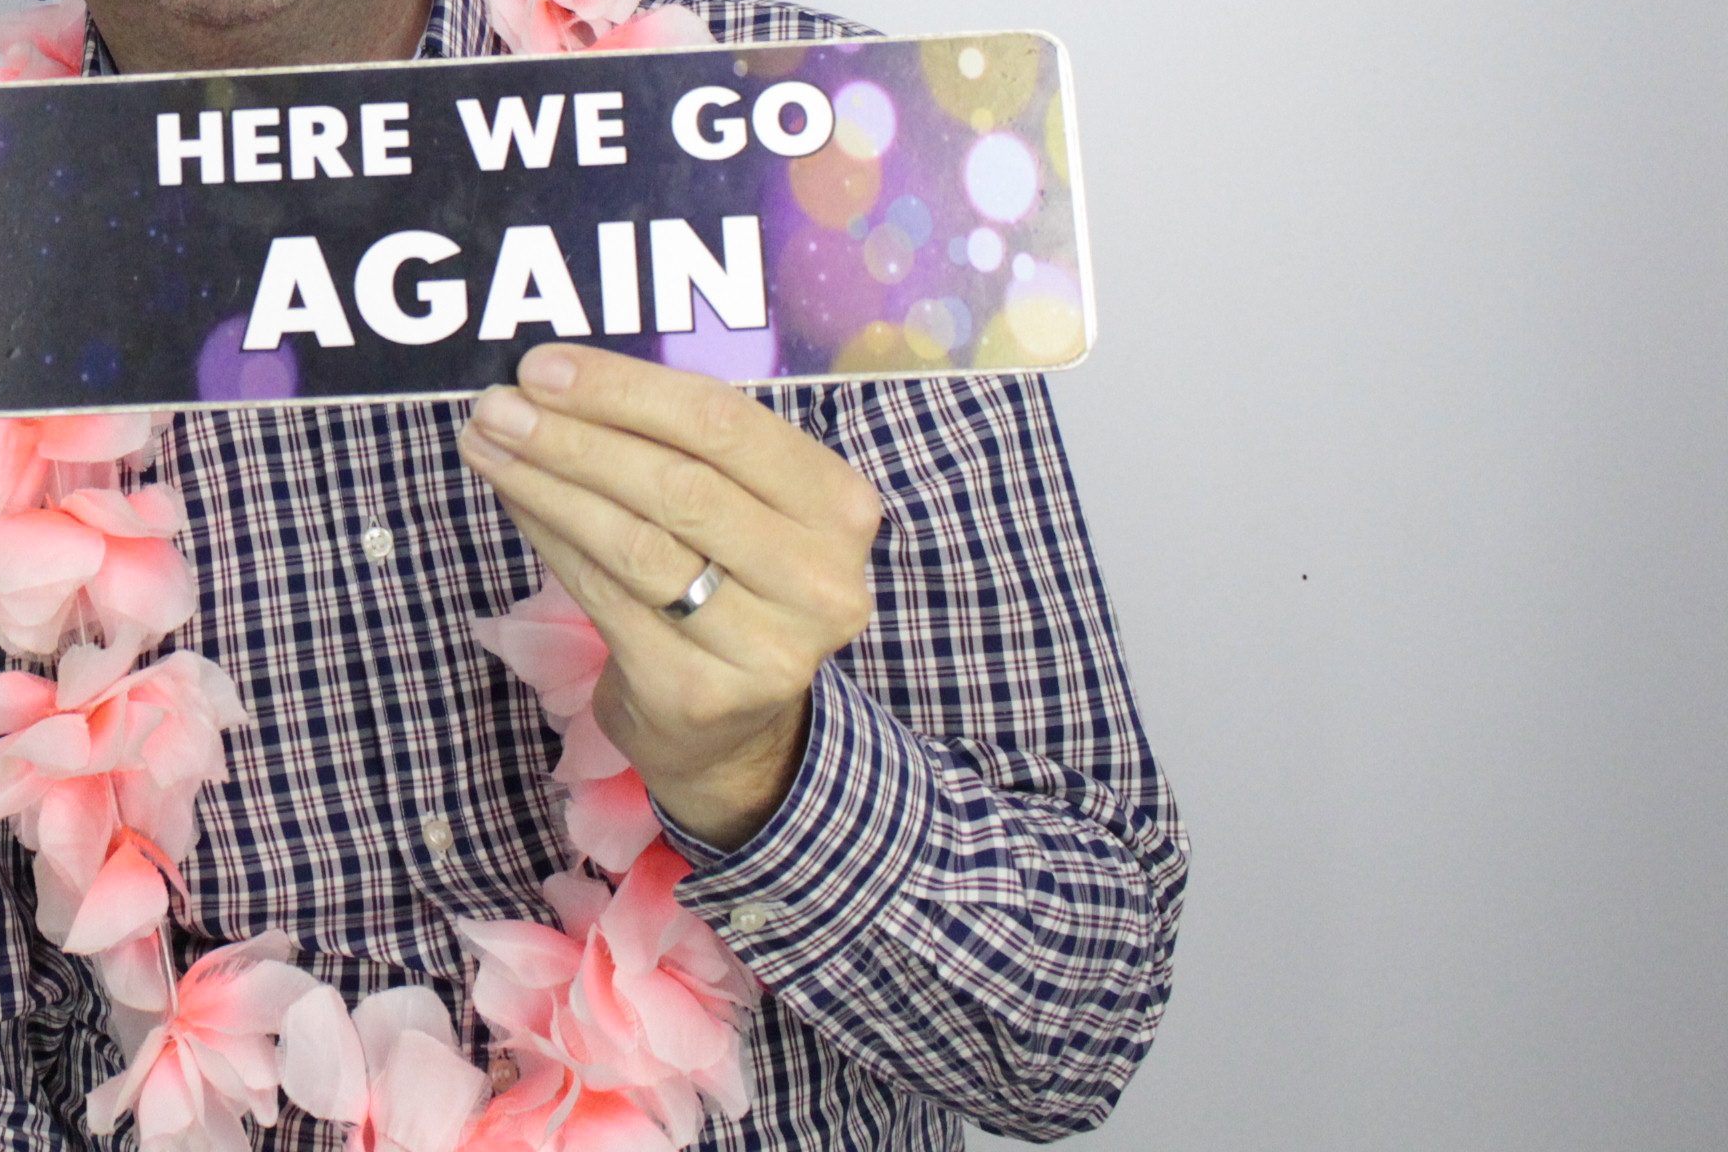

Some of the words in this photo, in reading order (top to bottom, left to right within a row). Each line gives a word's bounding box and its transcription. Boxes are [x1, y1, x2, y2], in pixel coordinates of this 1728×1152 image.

[156, 101, 413, 187] HERE
[454, 91, 628, 172] WE
[671, 80, 835, 161] GO
[241, 214, 768, 351] AGAIN
